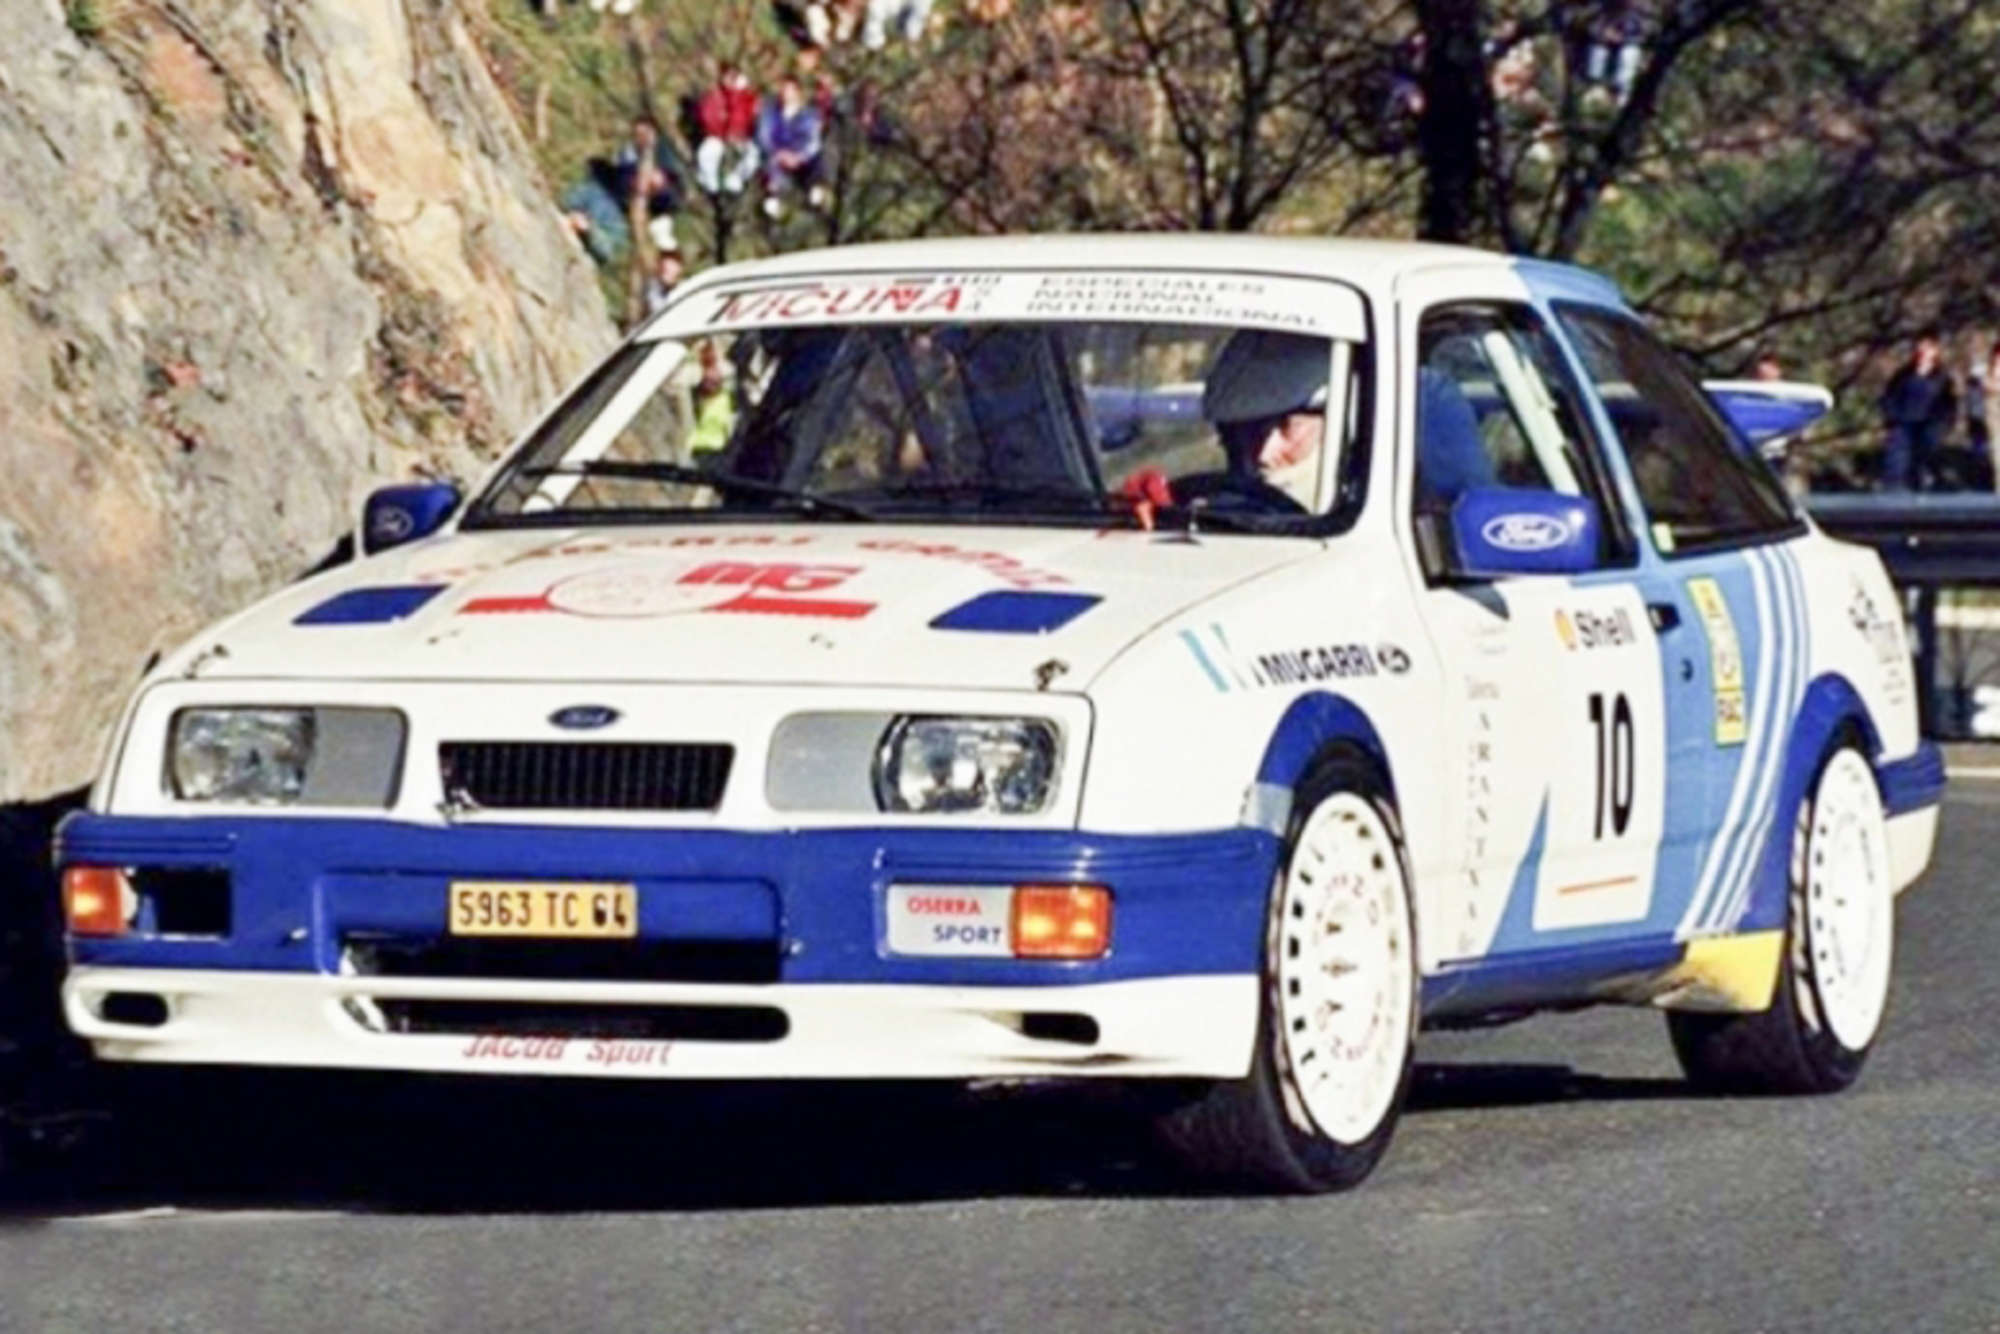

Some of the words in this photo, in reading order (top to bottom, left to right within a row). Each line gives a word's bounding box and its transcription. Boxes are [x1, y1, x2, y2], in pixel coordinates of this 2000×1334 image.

[1034, 287, 1216, 304] NACIONAL
[1040, 276, 1266, 295] ESPECIALES
[1025, 301, 1318, 326] INTERNACIONAL
[1493, 516, 1560, 548] Ford
[1574, 607, 1637, 648] Shell
[1258, 644, 1378, 685] MUGARRI
[1588, 691, 1634, 840] 10
[458, 891, 531, 926] 5963
[544, 891, 579, 927] TC
[592, 892, 628, 928] 64
[906, 896, 982, 916] OSERRA
[932, 924, 1003, 944] SPORT
[462, 1033, 570, 1061] JACOB
[586, 1037, 674, 1066] Sport
